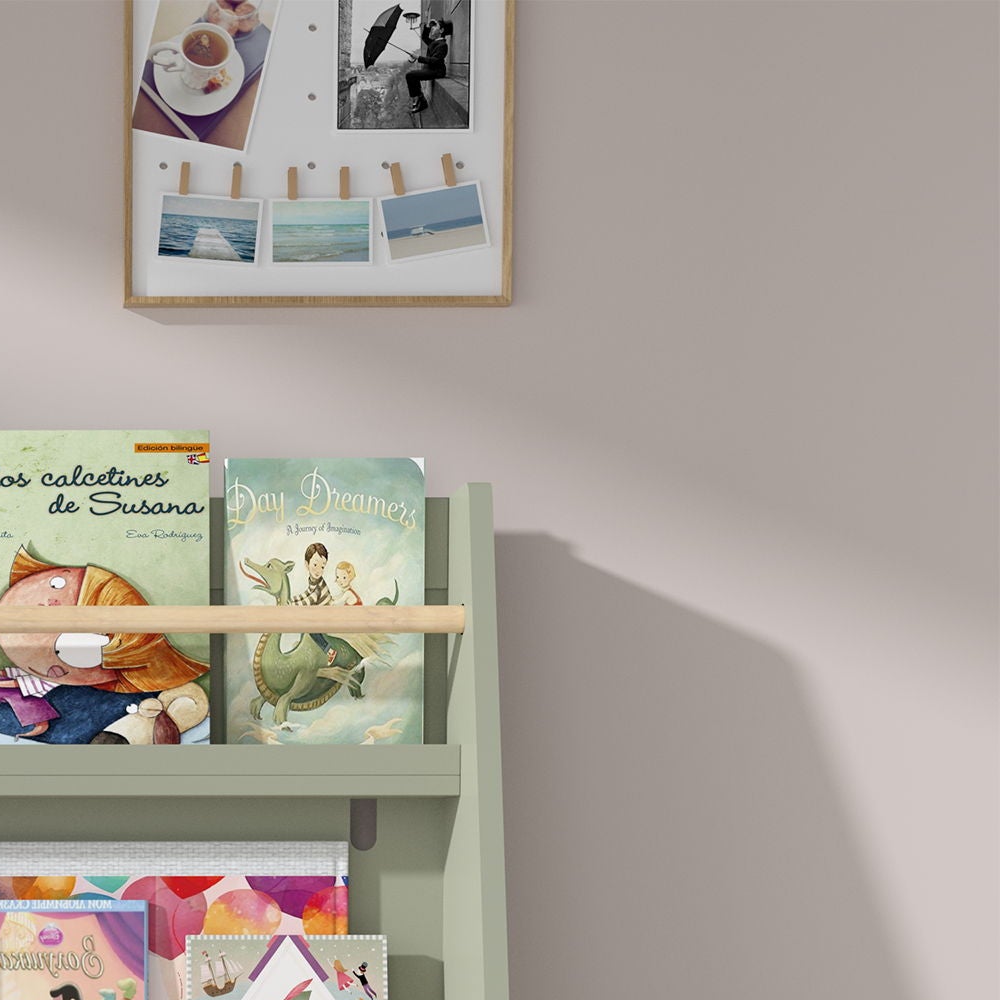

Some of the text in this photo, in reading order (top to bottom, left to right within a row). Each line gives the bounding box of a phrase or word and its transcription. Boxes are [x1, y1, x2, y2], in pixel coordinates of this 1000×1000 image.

[40, 465, 169, 488] calcetines
[48, 491, 205, 515] de Susana
[226, 466, 417, 531] Day Dreamers
[125, 529, 149, 539] Eva
